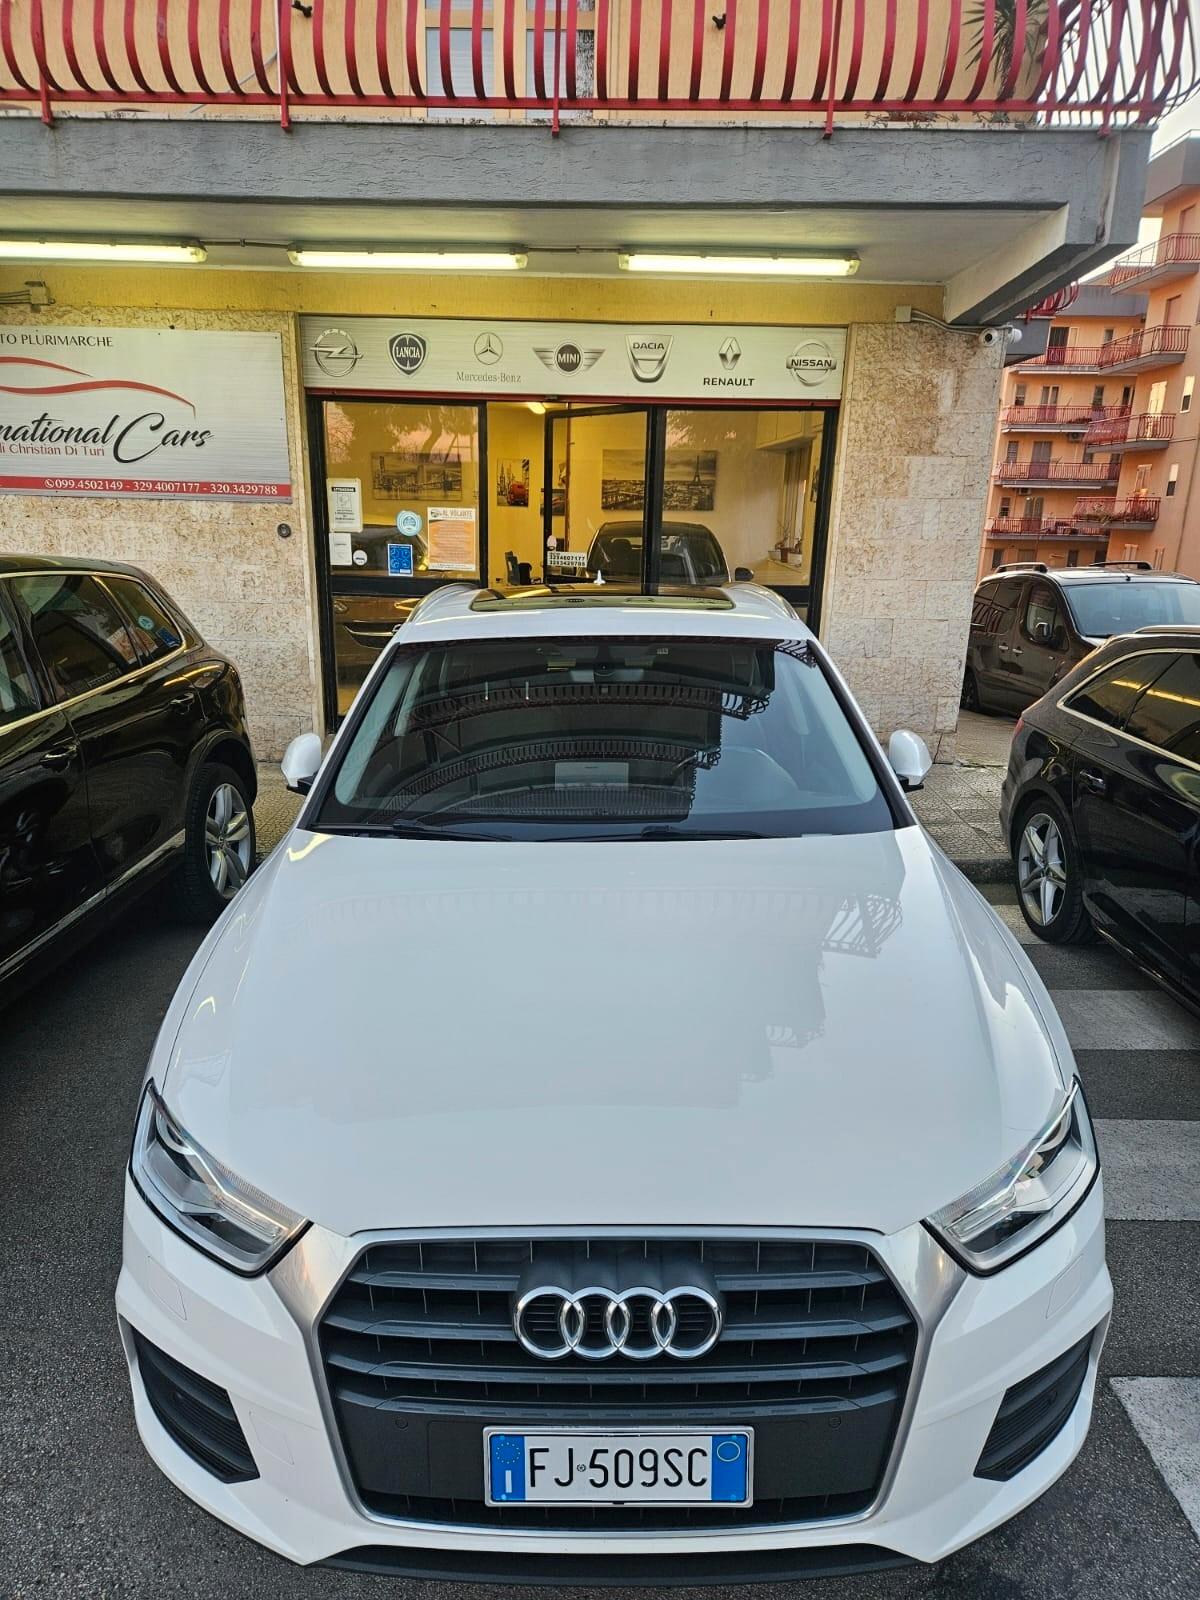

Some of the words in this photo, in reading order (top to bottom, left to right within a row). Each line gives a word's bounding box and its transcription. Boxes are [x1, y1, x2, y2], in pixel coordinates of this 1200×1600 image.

[21, 333, 113, 347] PLURIMARCHE
[633, 342, 665, 350] DACIA
[396, 347, 420, 358] LANCIA
[557, 353, 579, 364] MINI
[791, 358, 832, 368] NISSAN
[456, 371, 522, 383] Mercedes-Benz
[703, 377, 755, 387] RENAULT
[113, 412, 213, 463] Cars
[9, 443, 61, 456] Christian
[65, 445, 78, 456] Di
[81, 445, 105, 457] Turi
[55, 479, 123, 491] 099.4502149
[133, 481, 200, 492] 329.4007177
[210, 483, 278, 495] 320.3429788
